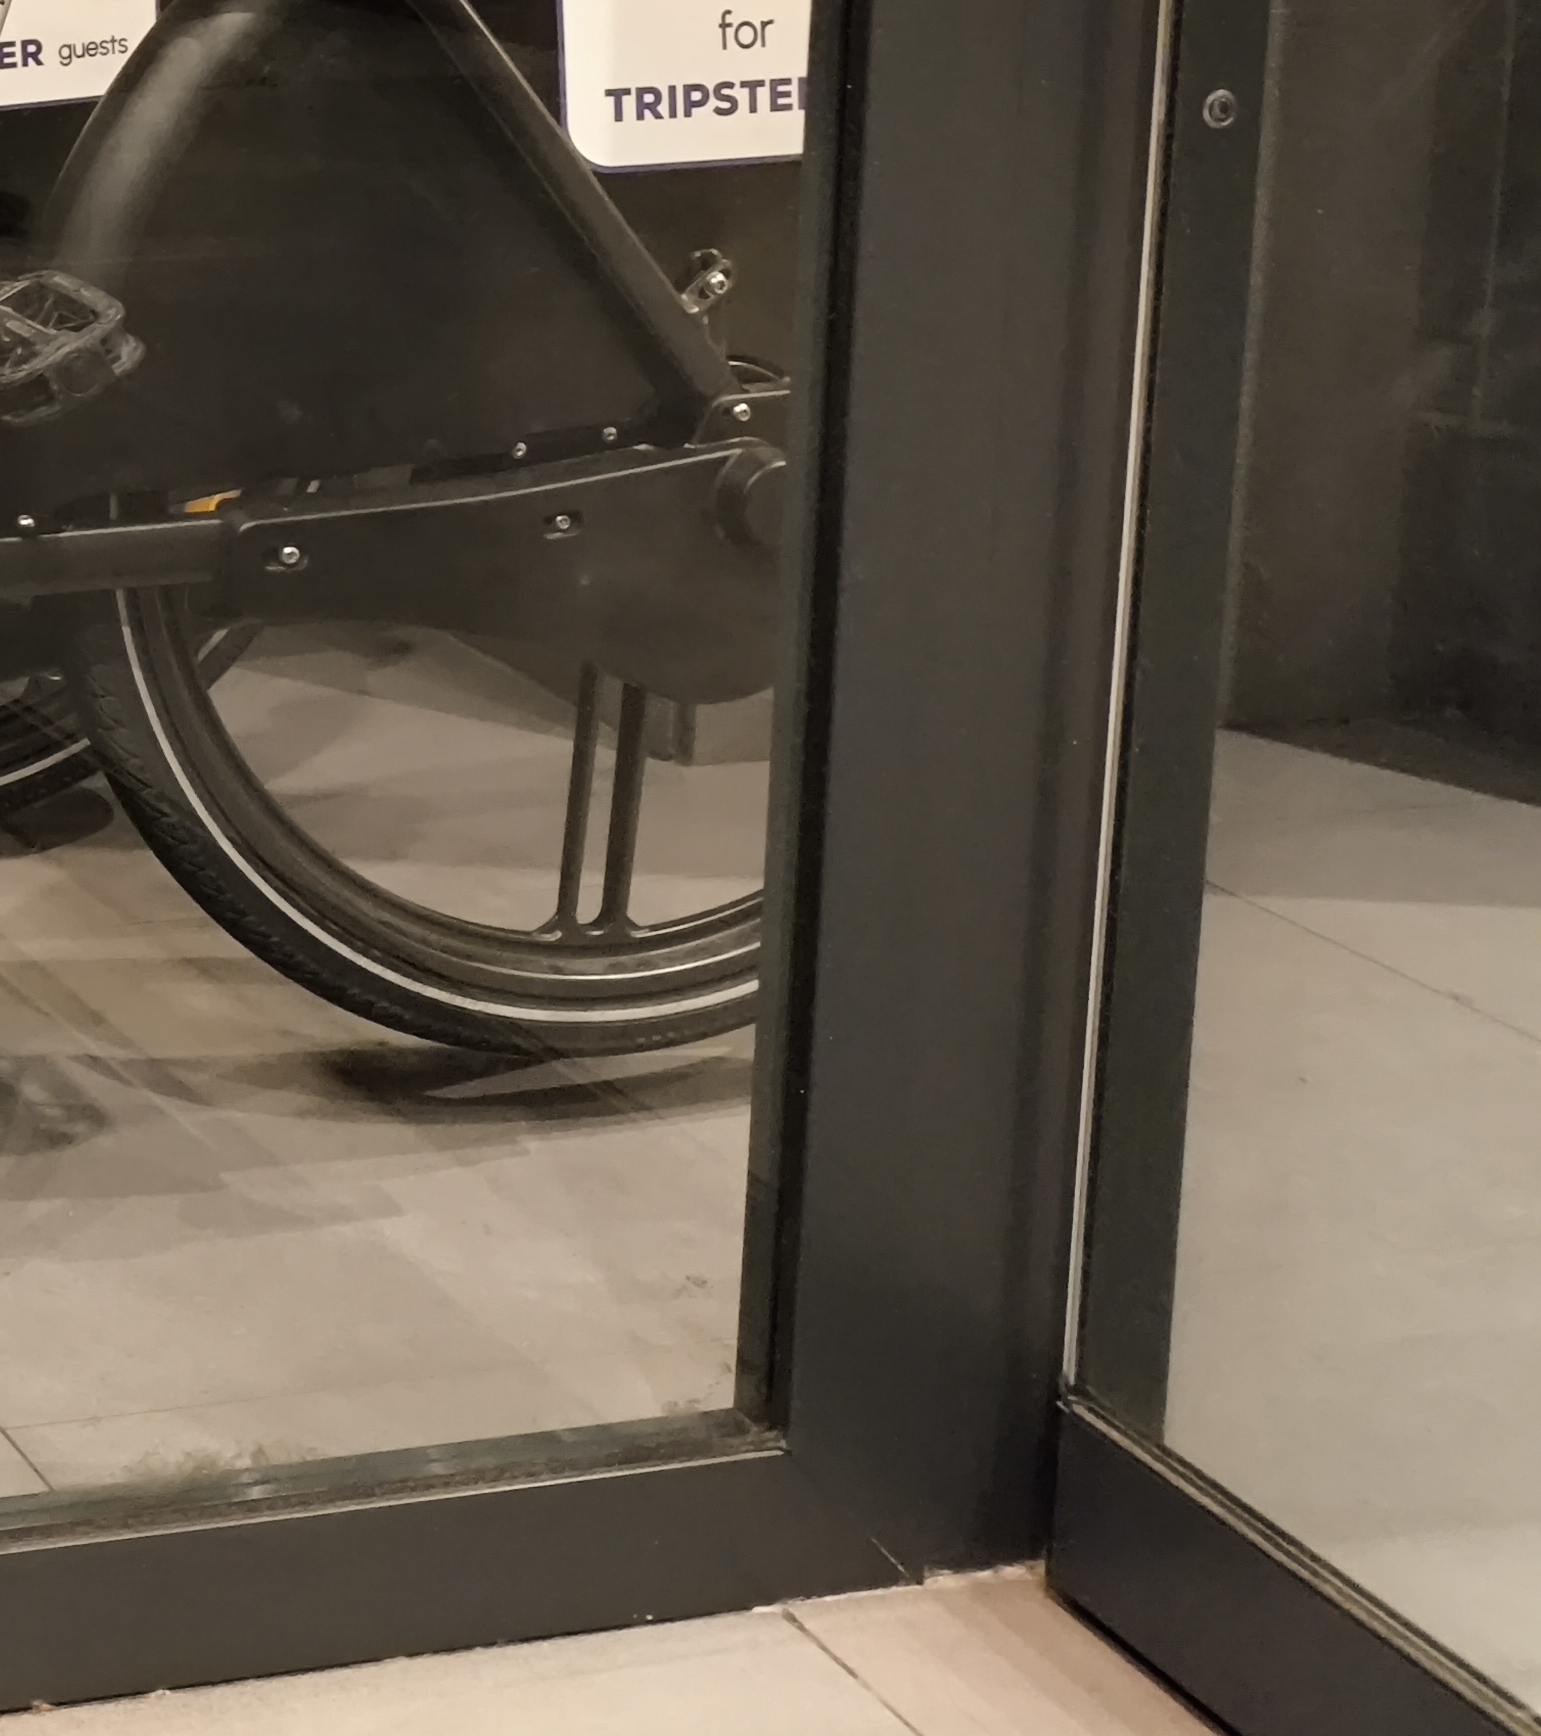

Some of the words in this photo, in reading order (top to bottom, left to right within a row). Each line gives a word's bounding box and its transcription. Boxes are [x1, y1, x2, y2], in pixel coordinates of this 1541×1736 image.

[58, 33, 129, 67] guests
[718, 9, 775, 51] for
[604, 76, 808, 123] TRIPSTE
